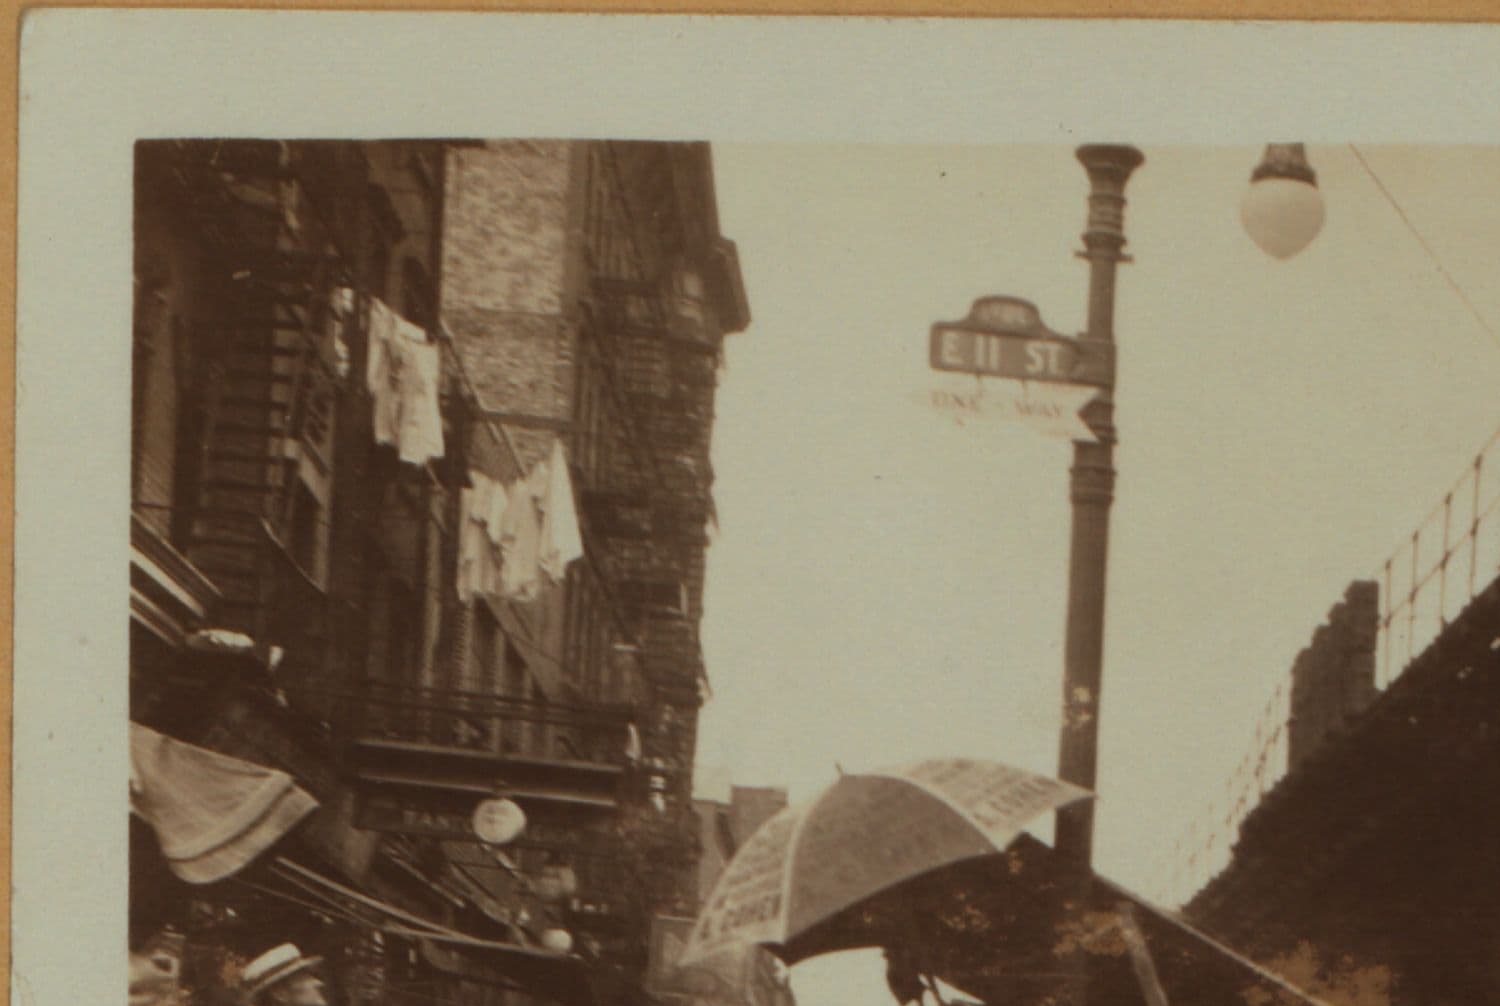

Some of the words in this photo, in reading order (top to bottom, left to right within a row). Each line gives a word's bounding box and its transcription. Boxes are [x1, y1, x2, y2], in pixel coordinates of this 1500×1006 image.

[942, 331, 964, 366] E
[975, 333, 1000, 371] 11
[1024, 341, 1065, 378] ST
